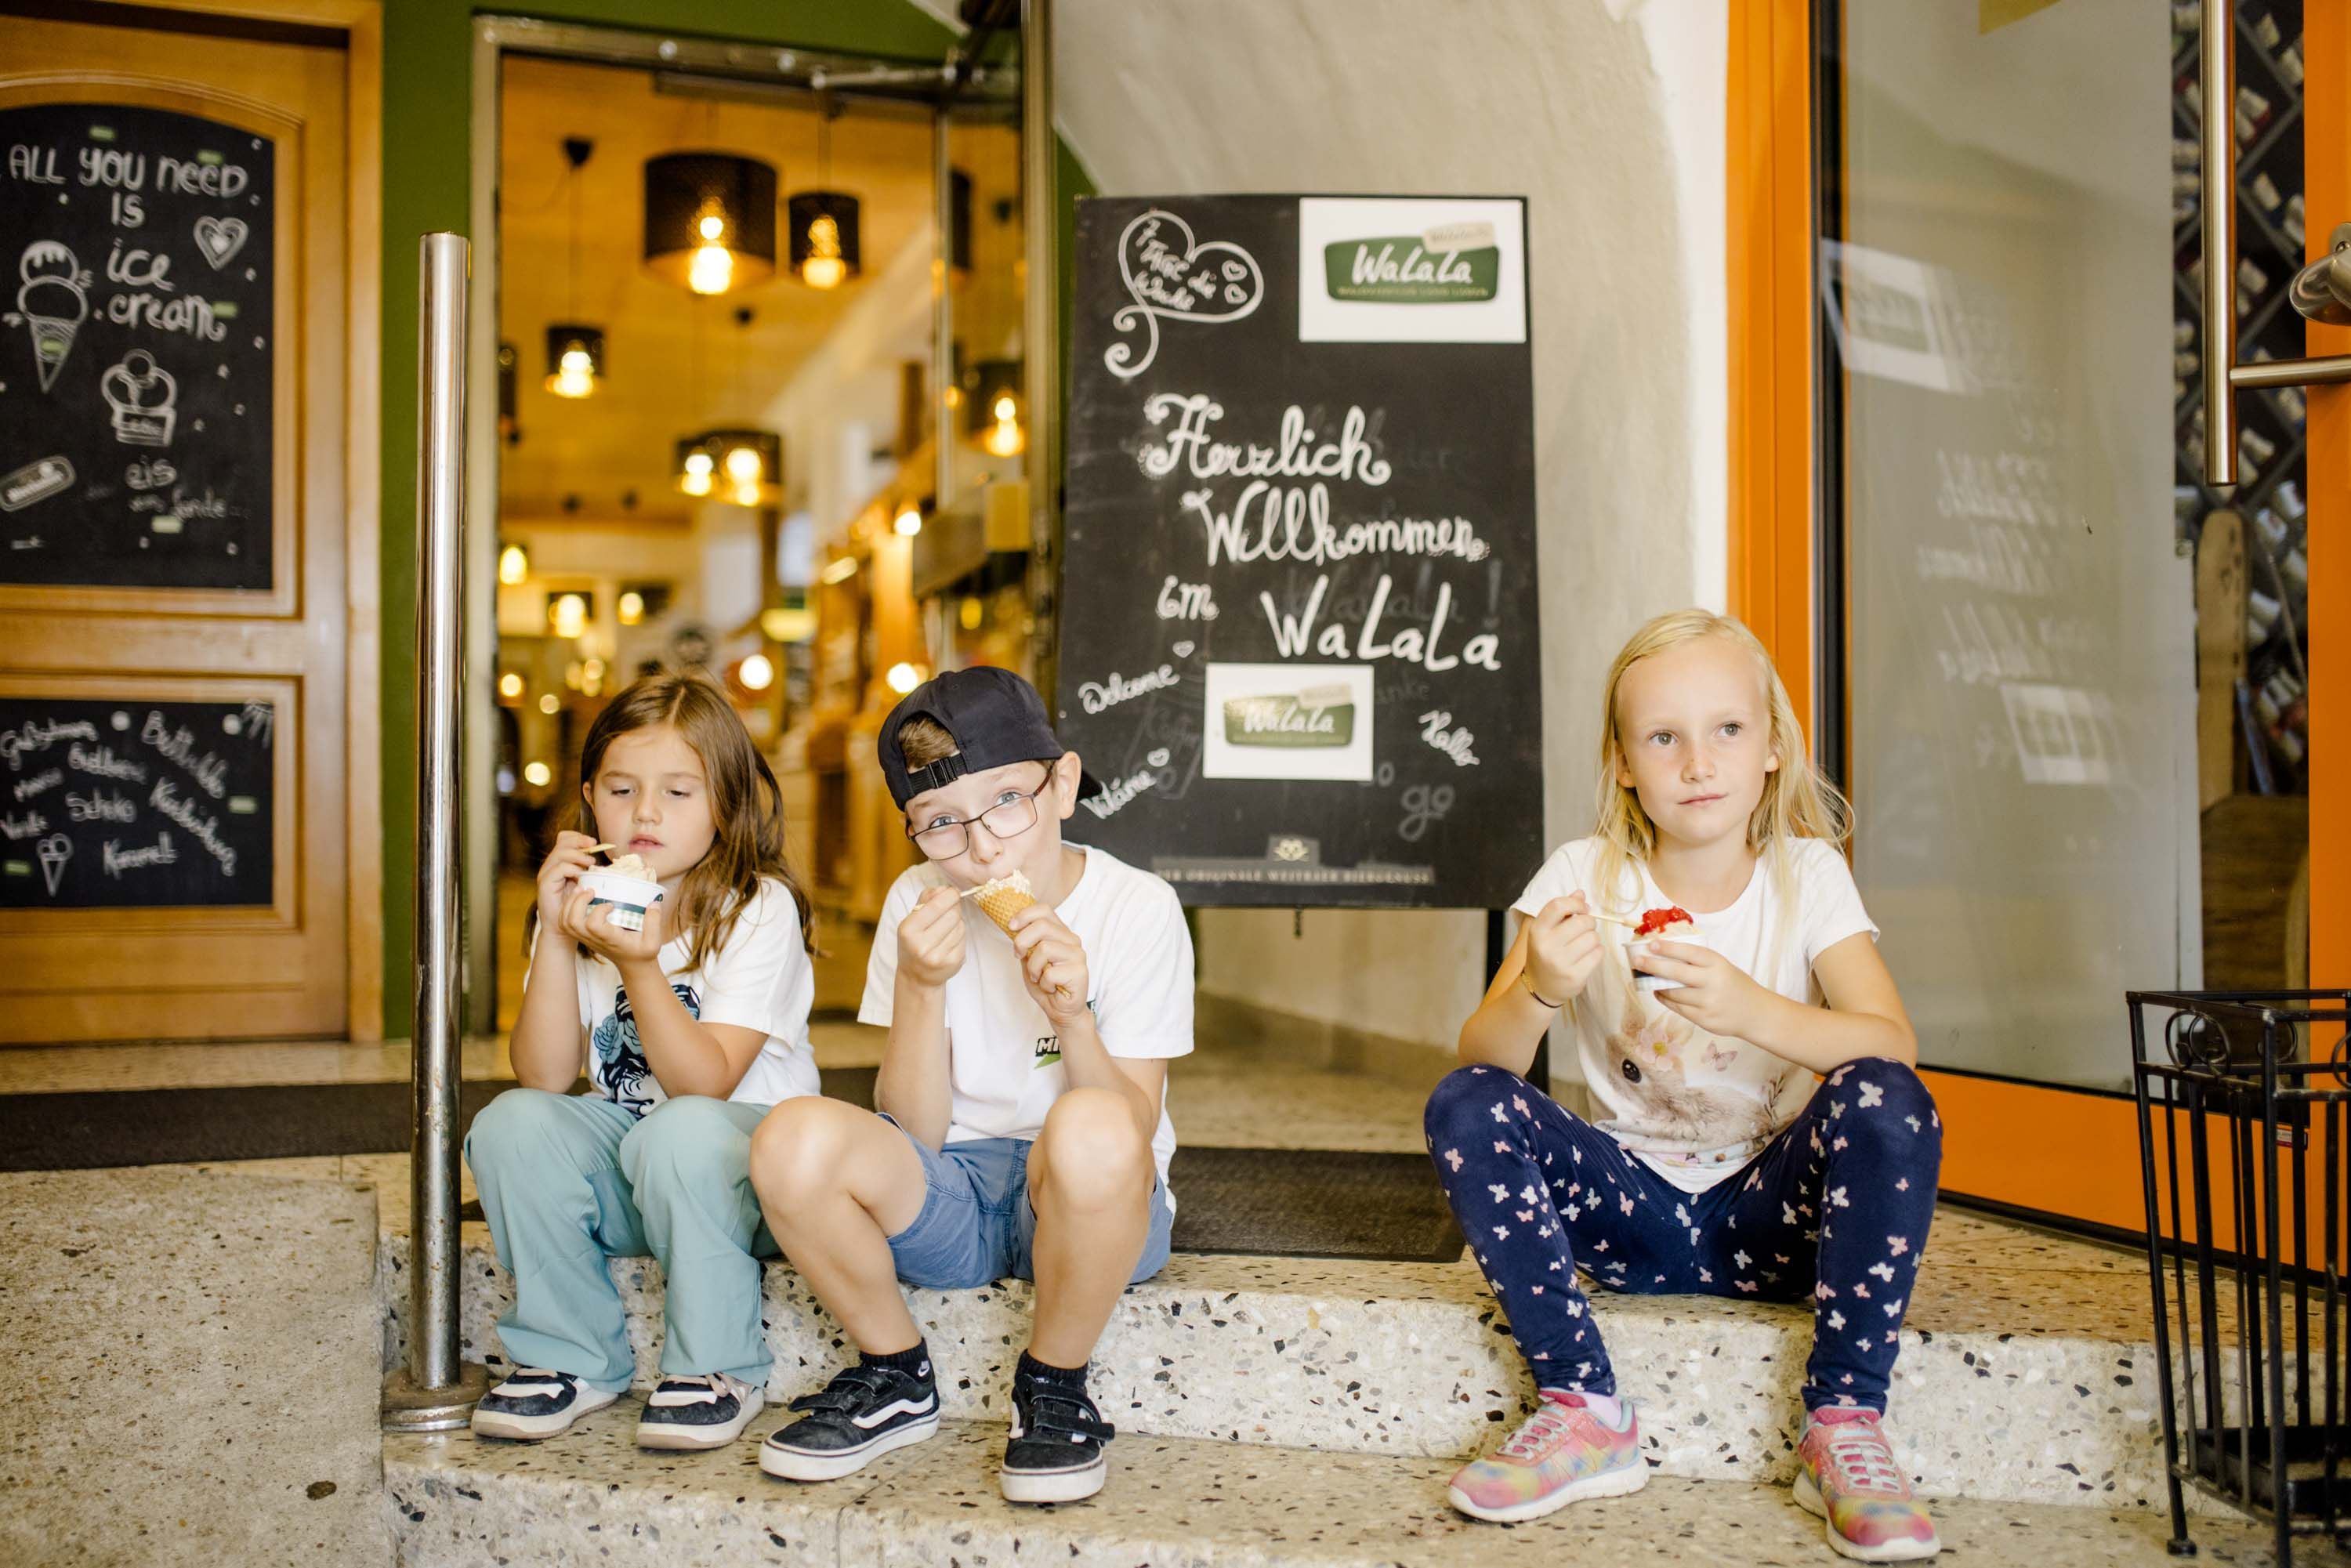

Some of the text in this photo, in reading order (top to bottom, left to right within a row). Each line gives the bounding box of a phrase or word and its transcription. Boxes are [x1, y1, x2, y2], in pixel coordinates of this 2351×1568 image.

[9, 144, 67, 184] ALL
[107, 237, 176, 292] ice
[1351, 243, 1474, 284] WaLaLa
[108, 292, 228, 342] cream
[1139, 393, 1392, 486] Herzlich
[1179, 480, 1491, 567] Willkommen
[1155, 574, 1220, 621] im
[1259, 574, 1502, 672] WaLaLa
[1244, 700, 1335, 733] WaLaLa
